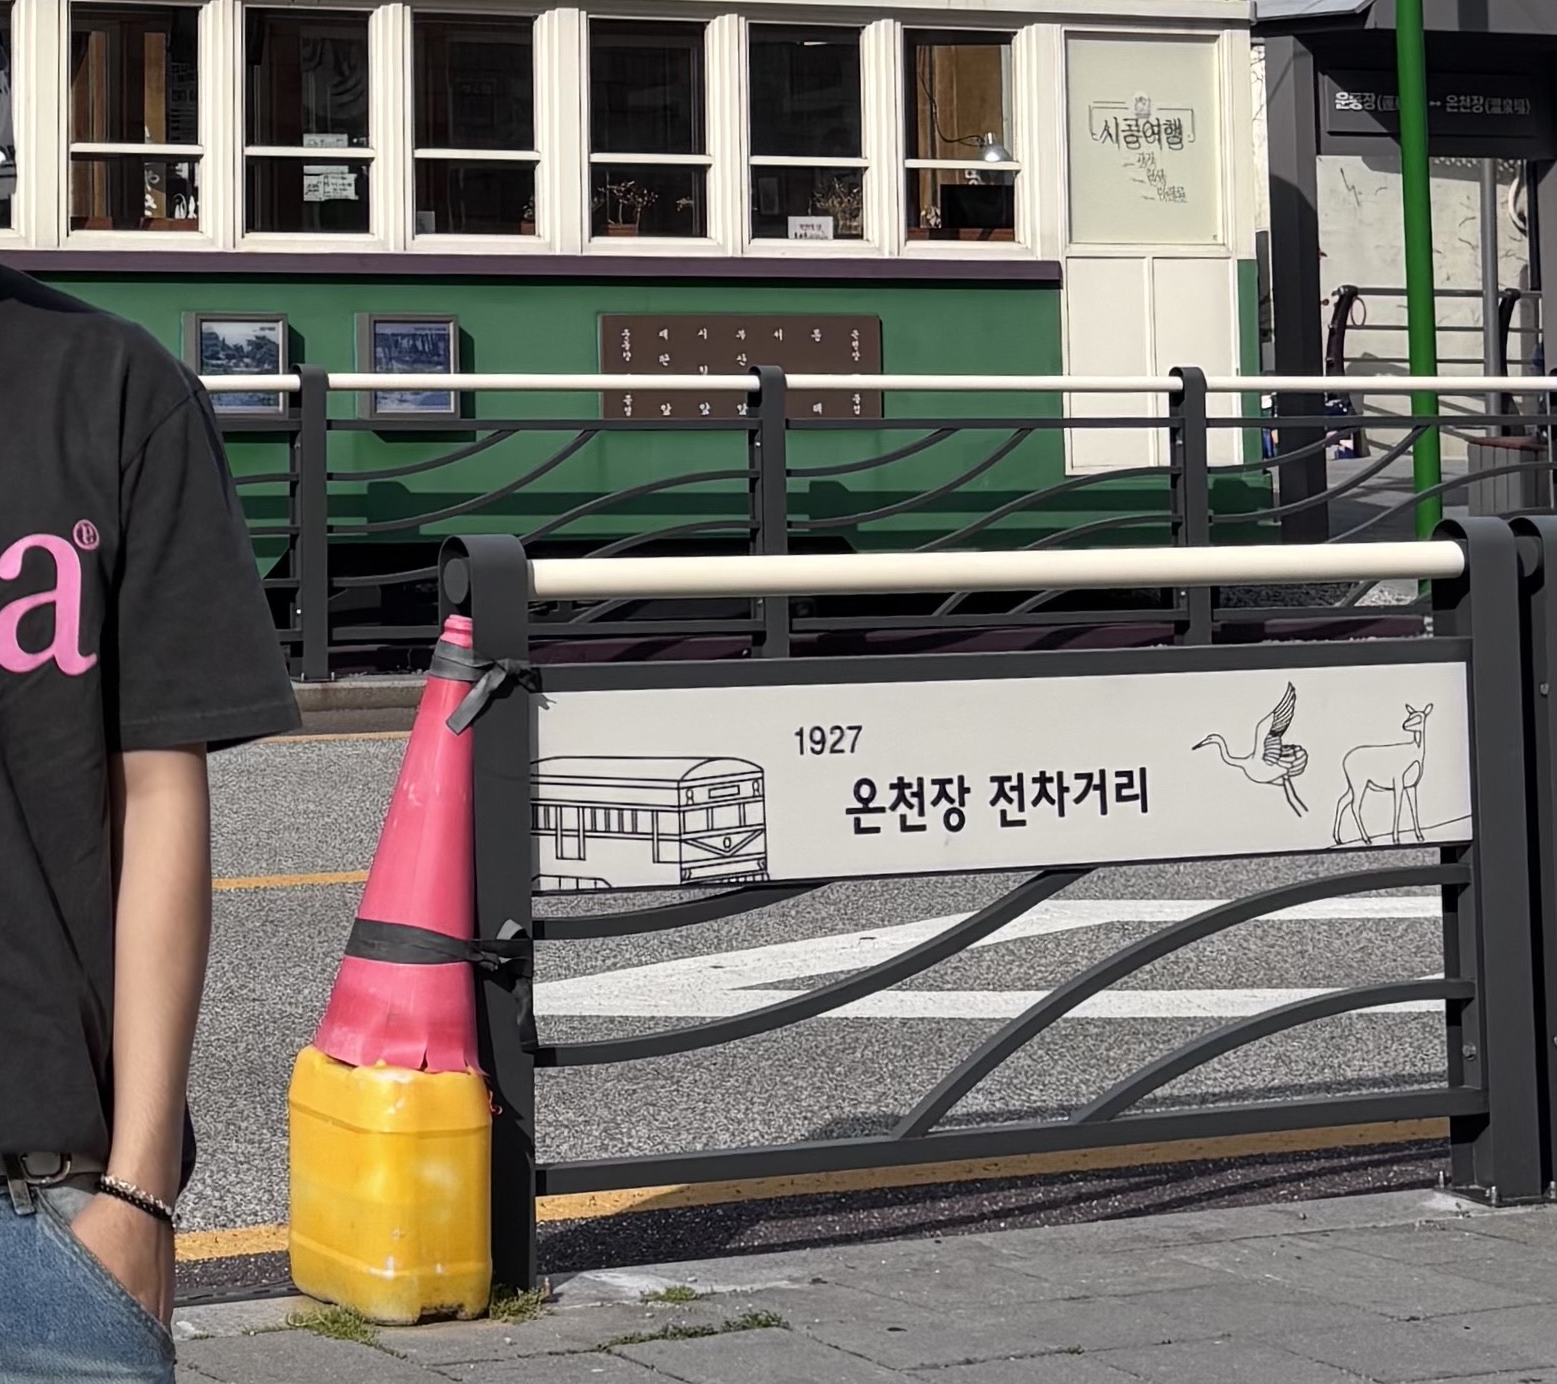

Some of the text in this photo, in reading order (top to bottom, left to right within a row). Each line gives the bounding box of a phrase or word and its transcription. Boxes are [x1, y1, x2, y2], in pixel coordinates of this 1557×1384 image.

[794, 725, 863, 756] 1927
[845, 766, 1148, 835] 온천장 전차거리
